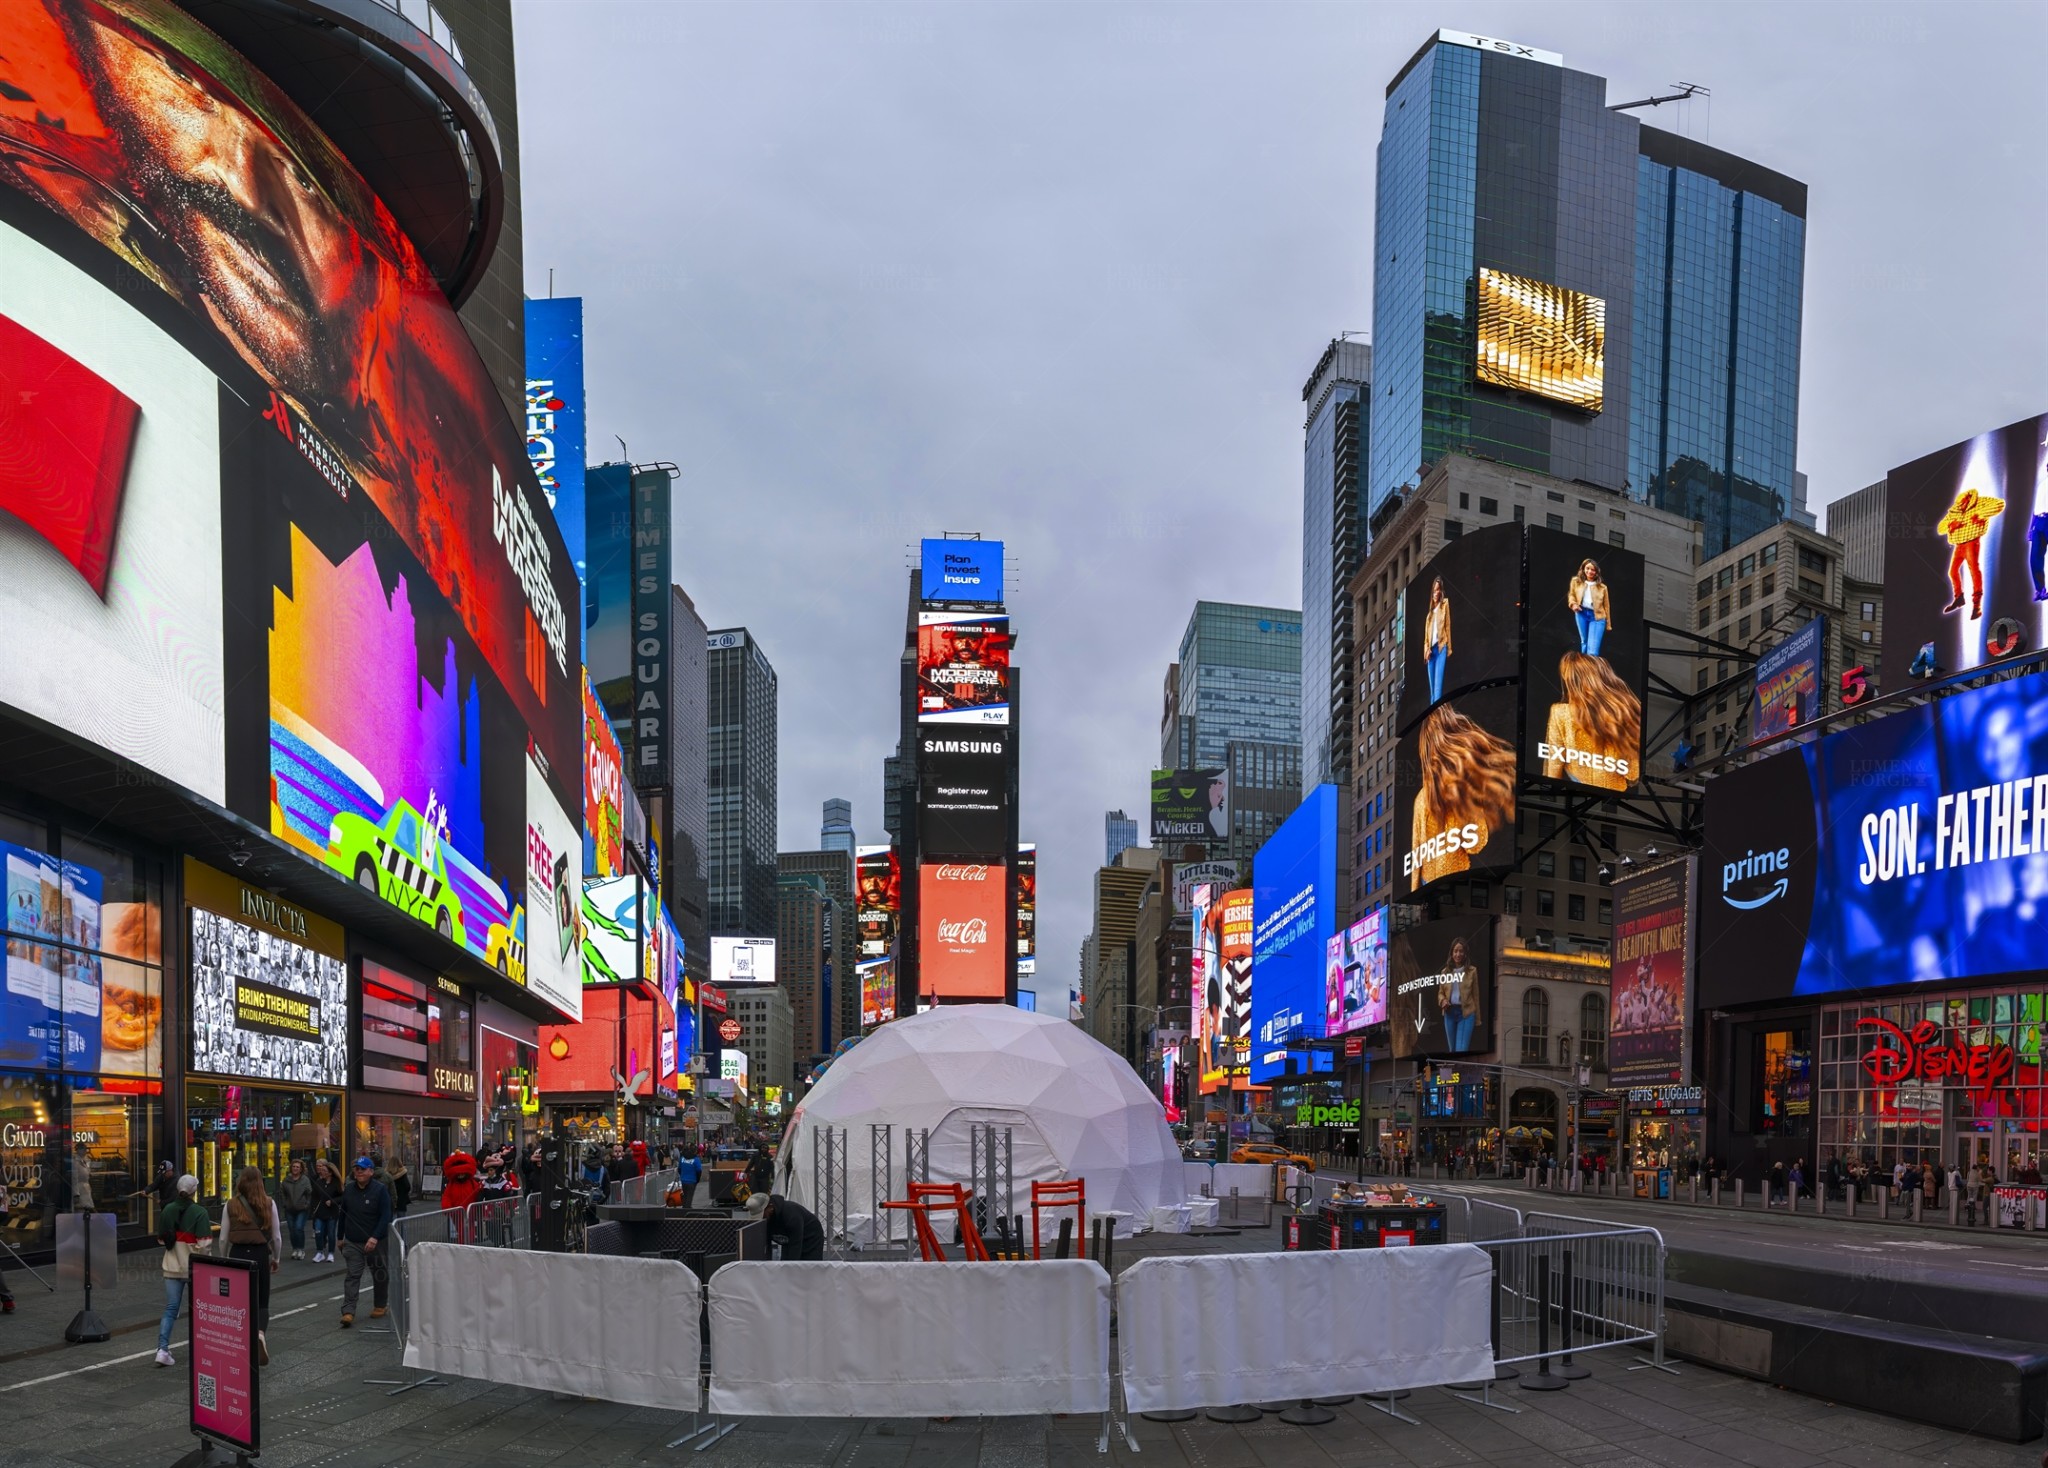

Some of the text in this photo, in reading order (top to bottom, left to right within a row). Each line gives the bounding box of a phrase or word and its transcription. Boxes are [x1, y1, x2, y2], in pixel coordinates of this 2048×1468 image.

[1470, 36, 1534, 57] TSX
[299, 422, 352, 488] MARRIOTT
[300, 439, 347, 498] MARQUIS
[493, 463, 566, 647] MODERN
[944, 554, 971, 564] Plan
[944, 565, 980, 574] Invest
[944, 574, 980, 584] Insure
[493, 500, 567, 679] WARFARE
[636, 486, 660, 766] TIMES SQUARE
[934, 625, 982, 633] NOVEMBER
[1789, 628, 1815, 651] CHANGE
[931, 669, 998, 678] MODERN
[931, 675, 999, 684] WARFARE
[1758, 656, 1786, 681] BROADWAY
[1841, 665, 1870, 704] 5
[1909, 641, 1936, 678] 4
[1757, 664, 1804, 706] BACK
[924, 740, 1002, 754] SAMSUNG
[1537, 742, 1629, 776] EXPRESS
[938, 787, 969, 796] Register
[1859, 773, 2048, 886] SON. FATHER
[528, 822, 552, 892] FREE
[1403, 823, 1479, 877] EXPRESS
[936, 864, 988, 880] Coca-Cola
[1179, 864, 1236, 892] LITTLE SHOP
[1723, 847, 1790, 892] prime
[241, 887, 308, 940] INVICTA
[387, 878, 434, 929] NYC
[1228, 898, 1247, 906] ONLY
[938, 918, 987, 944] Coca-Cola
[1224, 933, 1239, 946] TIMES
[1274, 933, 1289, 953] Place
[1289, 928, 1296, 943] to
[1296, 910, 1315, 937] Work!
[1616, 923, 1682, 963] A BEAUTIFUL NOISE
[437, 976, 460, 996] SEPHORA
[1397, 982, 1410, 995] SHOP
[1414, 975, 1435, 990] STORE
[1435, 972, 1465, 985] TODAY
[238, 987, 309, 1018] BRING THEM HOME
[238, 1007, 310, 1032] #KIDNAPPEDFROMISRAEL
[1629, 1087, 1701, 1101] GIFTS LUGGAGE
[1314, 1098, 1360, 1126] pelé
[1994, 1187, 2047, 1200] CHICAGO
[196, 1298, 246, 1320] See something?
[199, 1310, 244, 1331] Do something.
[229, 1366, 240, 1375] TEXT
